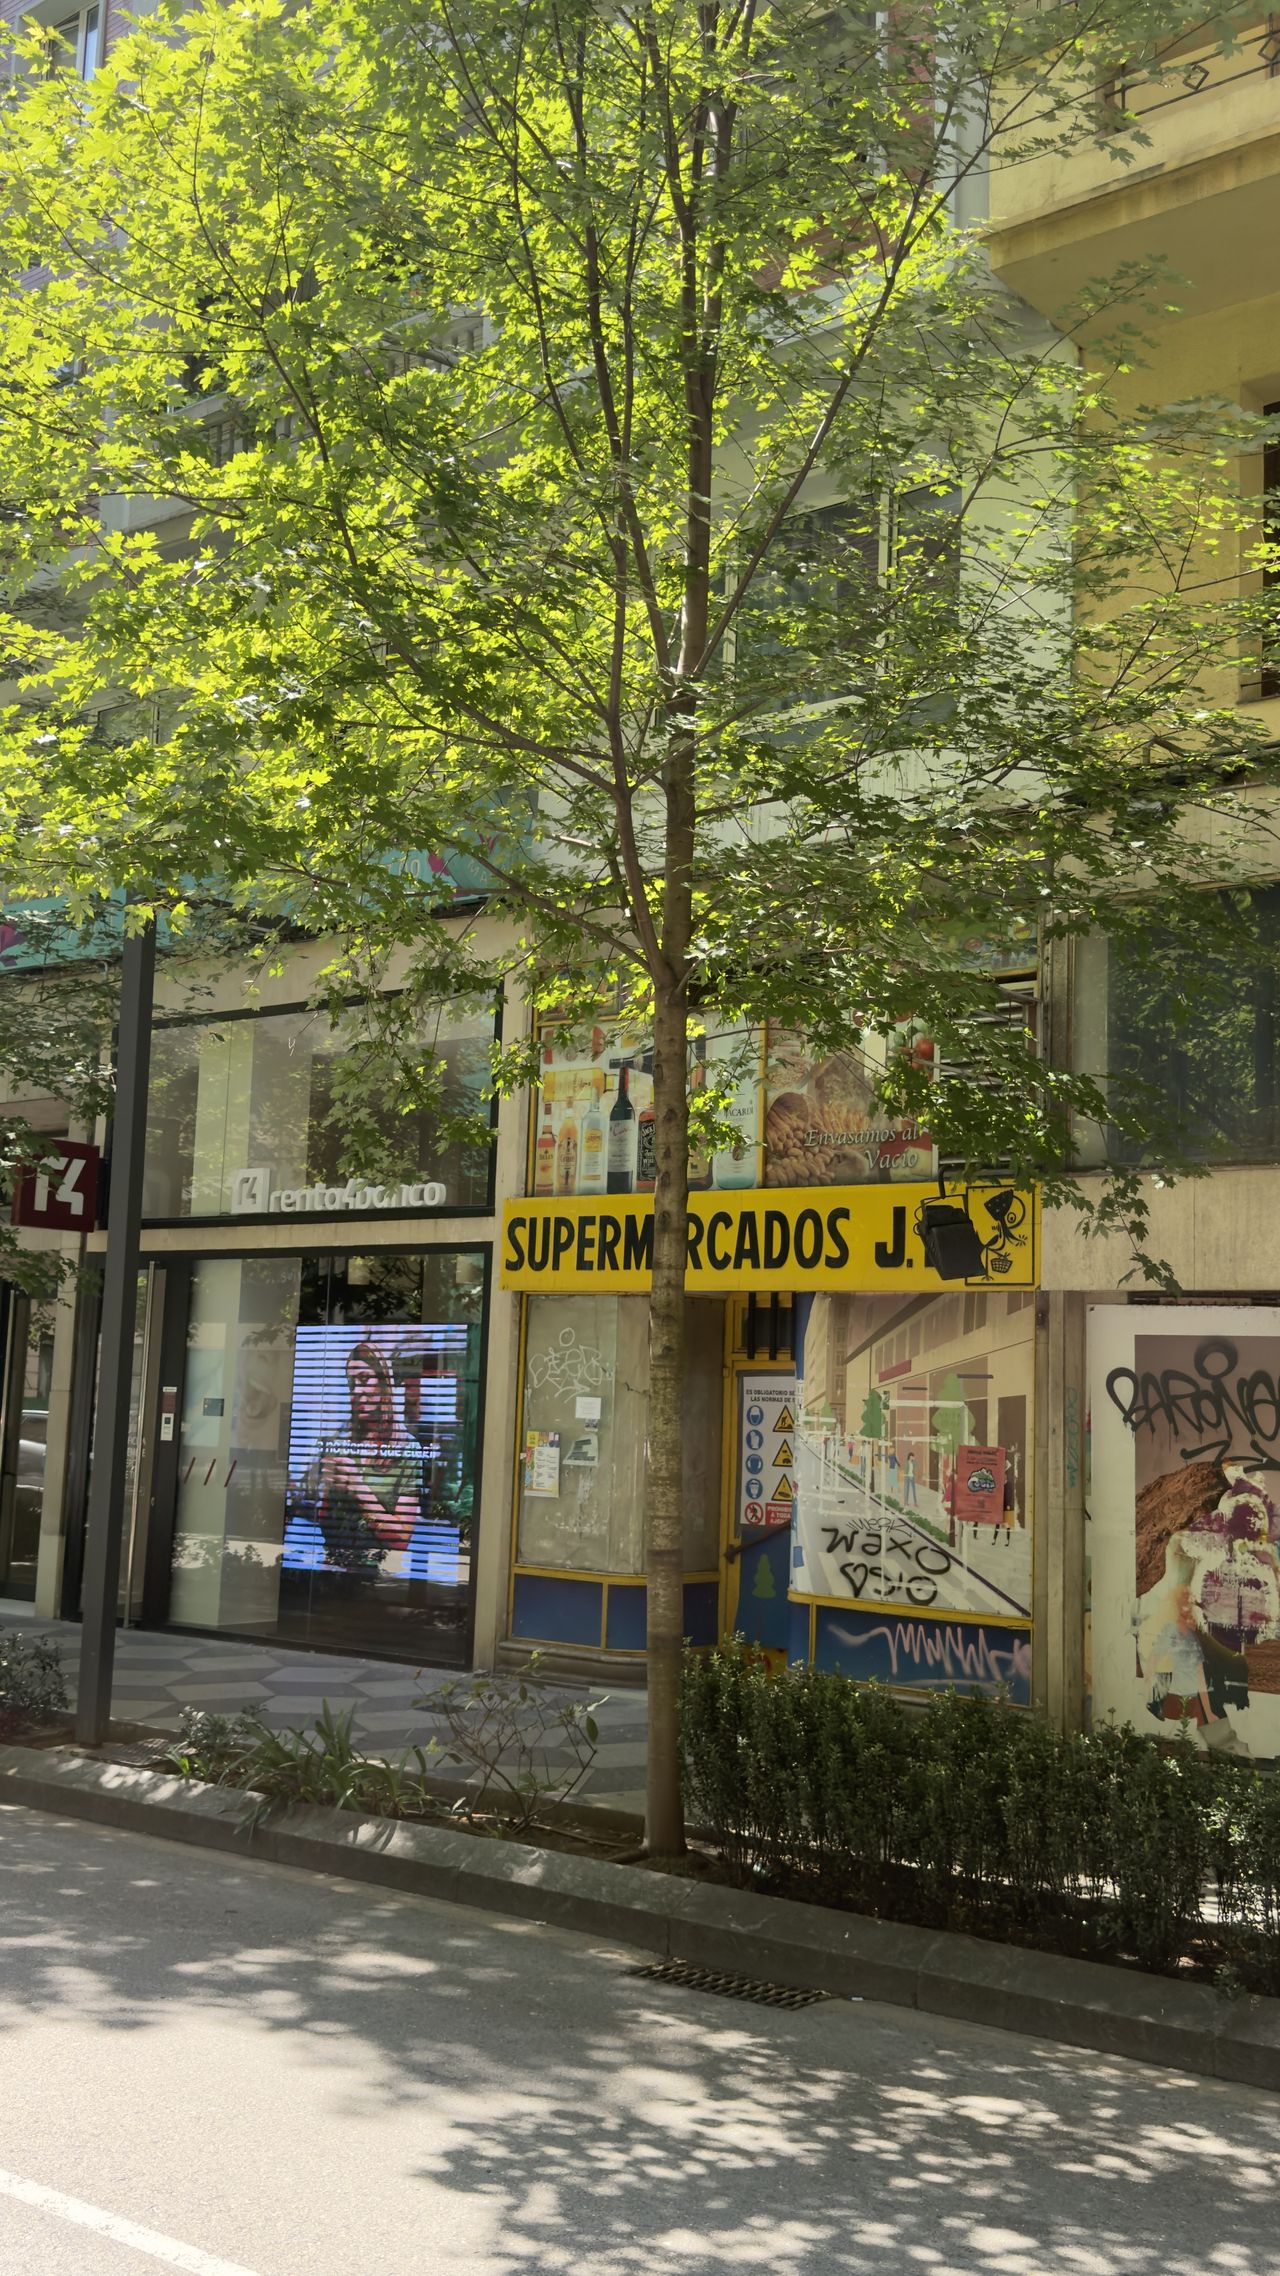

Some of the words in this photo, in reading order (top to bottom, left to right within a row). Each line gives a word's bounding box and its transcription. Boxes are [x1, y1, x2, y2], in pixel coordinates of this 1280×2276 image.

[804, 1128, 896, 1147] Envasamos
[902, 1126, 918, 1141] al
[505, 1207, 850, 1271] SUPERMRCADOS
[875, 1206, 937, 1268] J.
